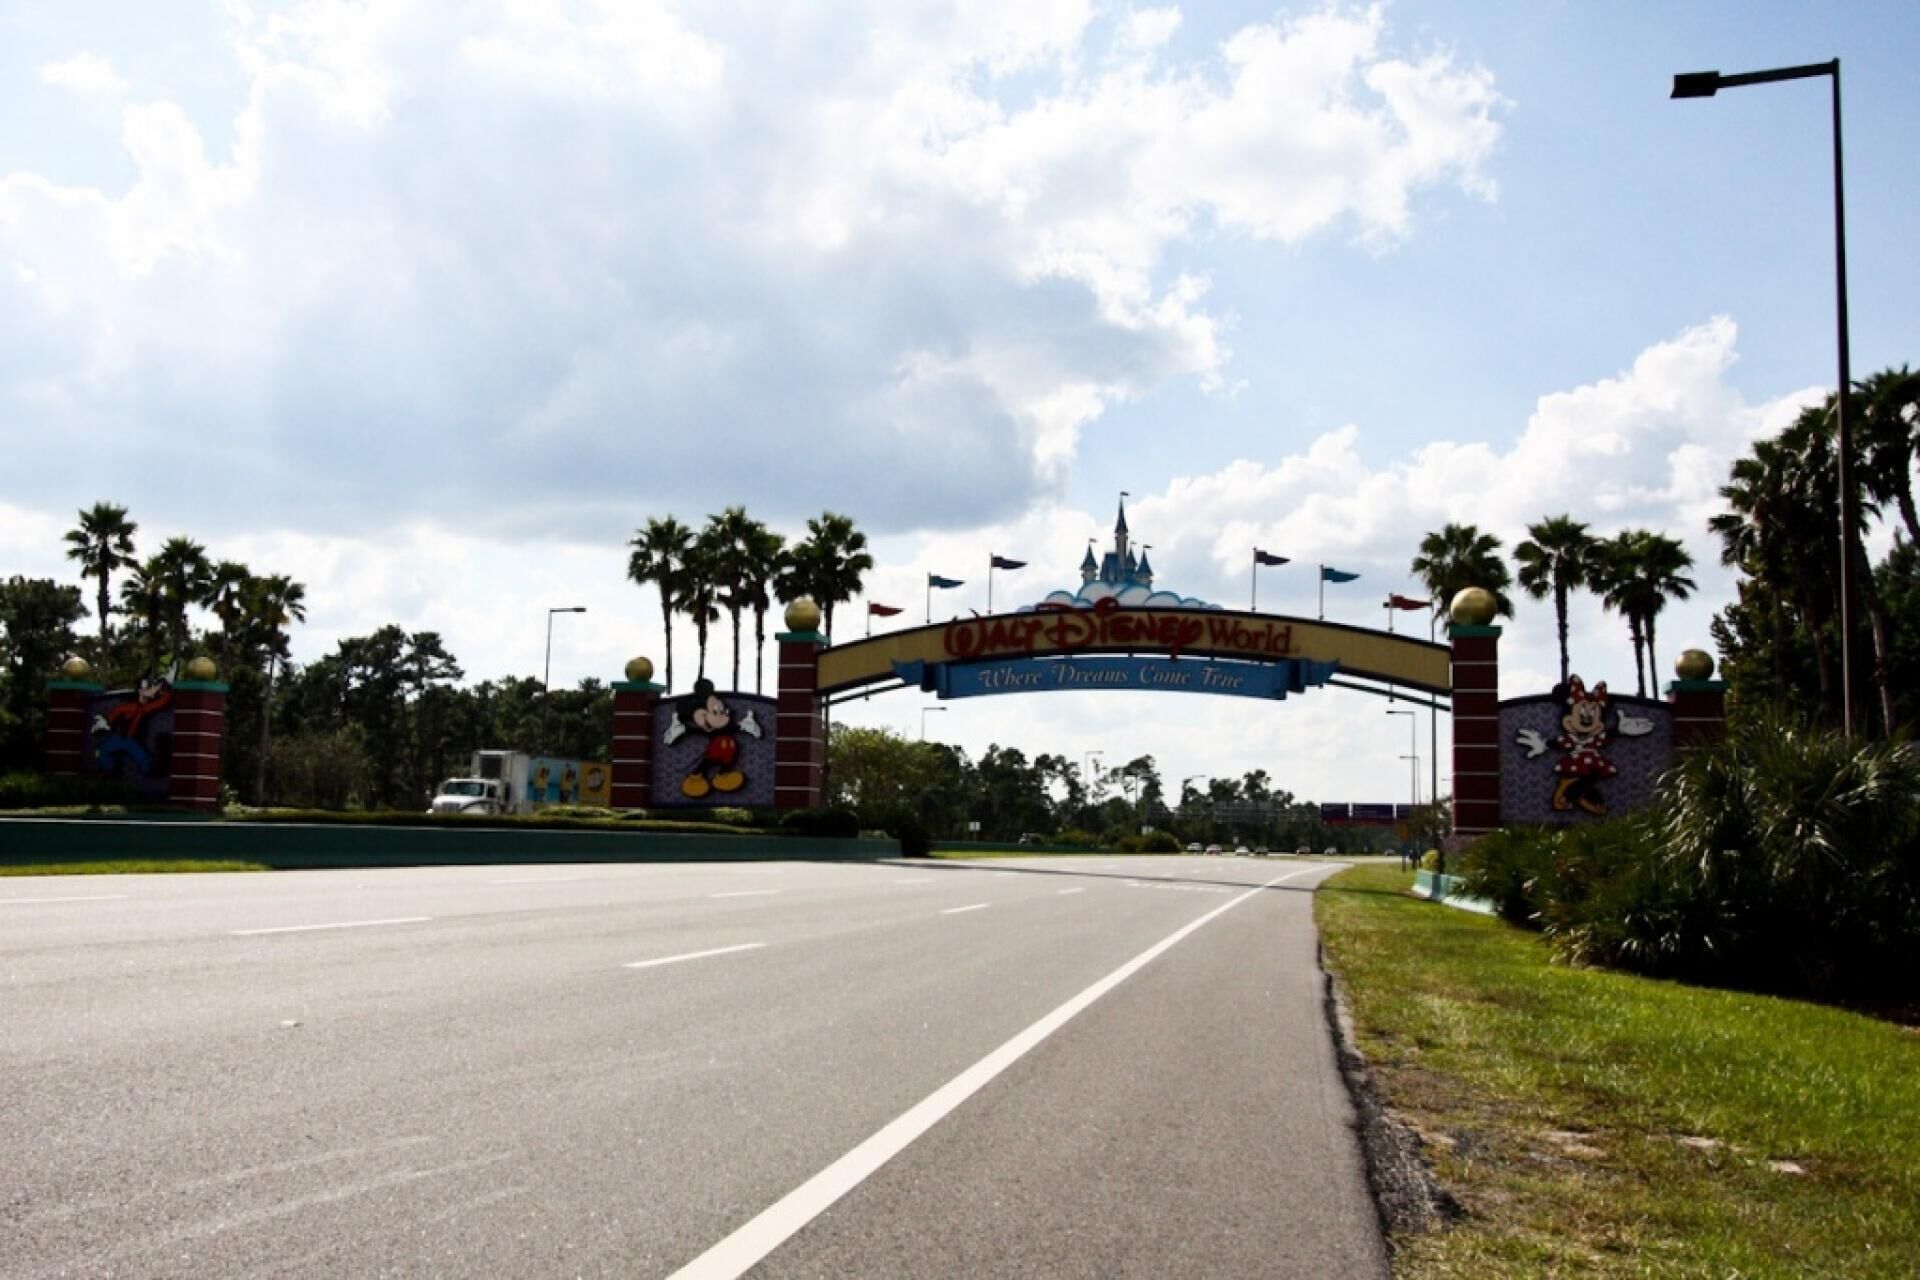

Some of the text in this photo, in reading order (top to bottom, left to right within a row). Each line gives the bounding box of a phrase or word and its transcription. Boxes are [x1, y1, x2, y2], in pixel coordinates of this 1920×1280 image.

[1205, 616, 1293, 654] World
[978, 663, 1244, 688] Where Dreams Come True
